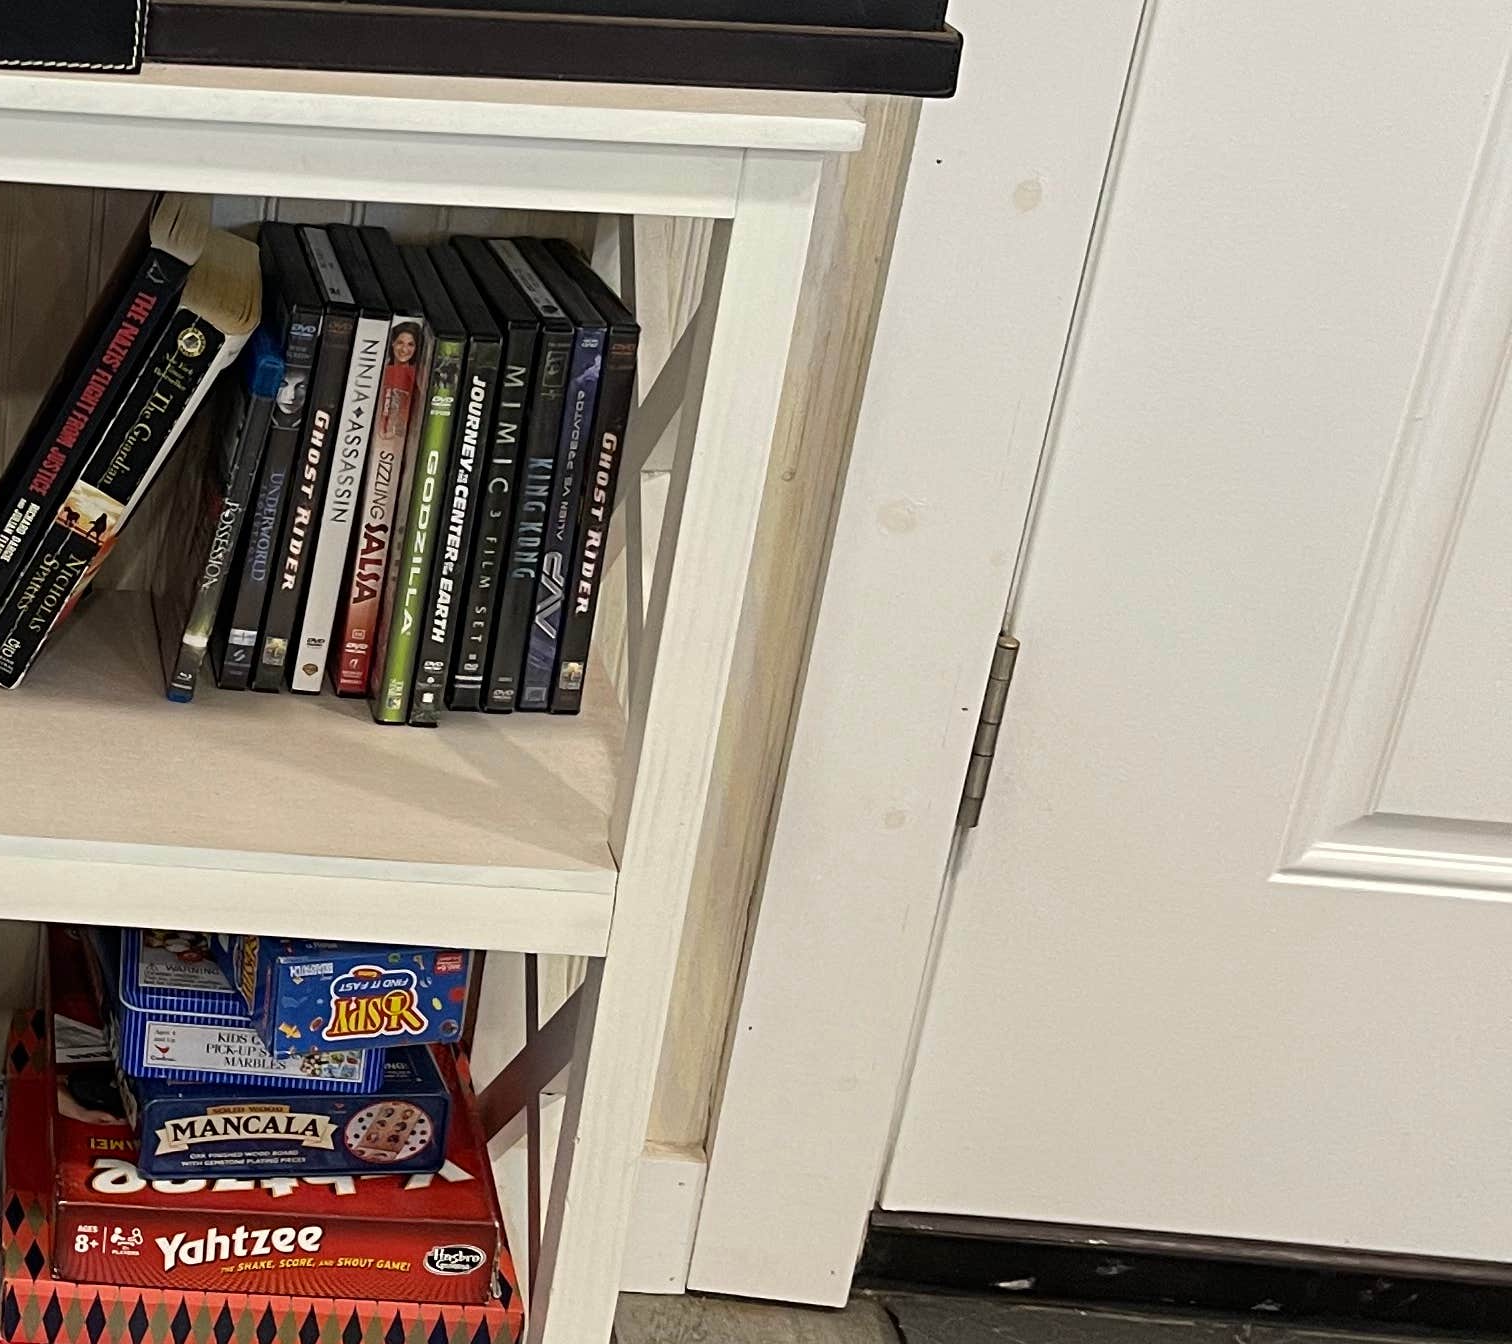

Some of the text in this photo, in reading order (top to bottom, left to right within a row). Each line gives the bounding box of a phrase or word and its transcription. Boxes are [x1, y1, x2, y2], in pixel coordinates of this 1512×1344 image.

[125, 291, 157, 325] THE
[290, 322, 318, 337] DVD
[75, 368, 113, 414] FLIGHT
[141, 390, 174, 420] The
[55, 410, 90, 449] FROM
[103, 421, 153, 485] Guardian
[330, 338, 381, 524] NINJA ASSASSIN
[488, 364, 527, 495] MIMIC
[565, 389, 586, 471] PREDATOR
[28, 446, 67, 497] JUSTICE
[370, 450, 395, 521] SIZZLING
[281, 409, 331, 591] GHOST RIDER
[431, 375, 486, 644] JOURNEY CENTER EARTH
[490, 509, 502, 519] 3
[511, 457, 554, 580] KING KONG
[574, 430, 618, 615] GHOST RIDER
[201, 497, 242, 590] POSSESSION
[251, 472, 285, 583] UNDERWORLD
[400, 450, 439, 635] GODZILLA
[16, 552, 60, 612] SPARKS
[352, 522, 389, 605] SALSA
[479, 536, 497, 589] FILM
[28, 553, 88, 633] NICHOLAS
[469, 605, 487, 642] SET
[338, 976, 410, 993] FIND IT FAST
[217, 1032, 248, 1045] KIDS
[326, 998, 382, 1036] SPY
[206, 1044, 256, 1057] PICK-UP
[224, 1056, 287, 1071] MARBLES
[172, 1115, 321, 1142] MANCALA
[74, 1234, 100, 1253] 8+
[77, 1224, 99, 1234] AGES
[155, 1225, 324, 1272] Yahtzee
[236, 1262, 277, 1273] SHAKE,
[278, 1259, 316, 1270] SCORE,
[336, 1258, 375, 1269] SHOUT
[375, 1260, 412, 1273] GAME!
[434, 1248, 481, 1264] Hasbro
